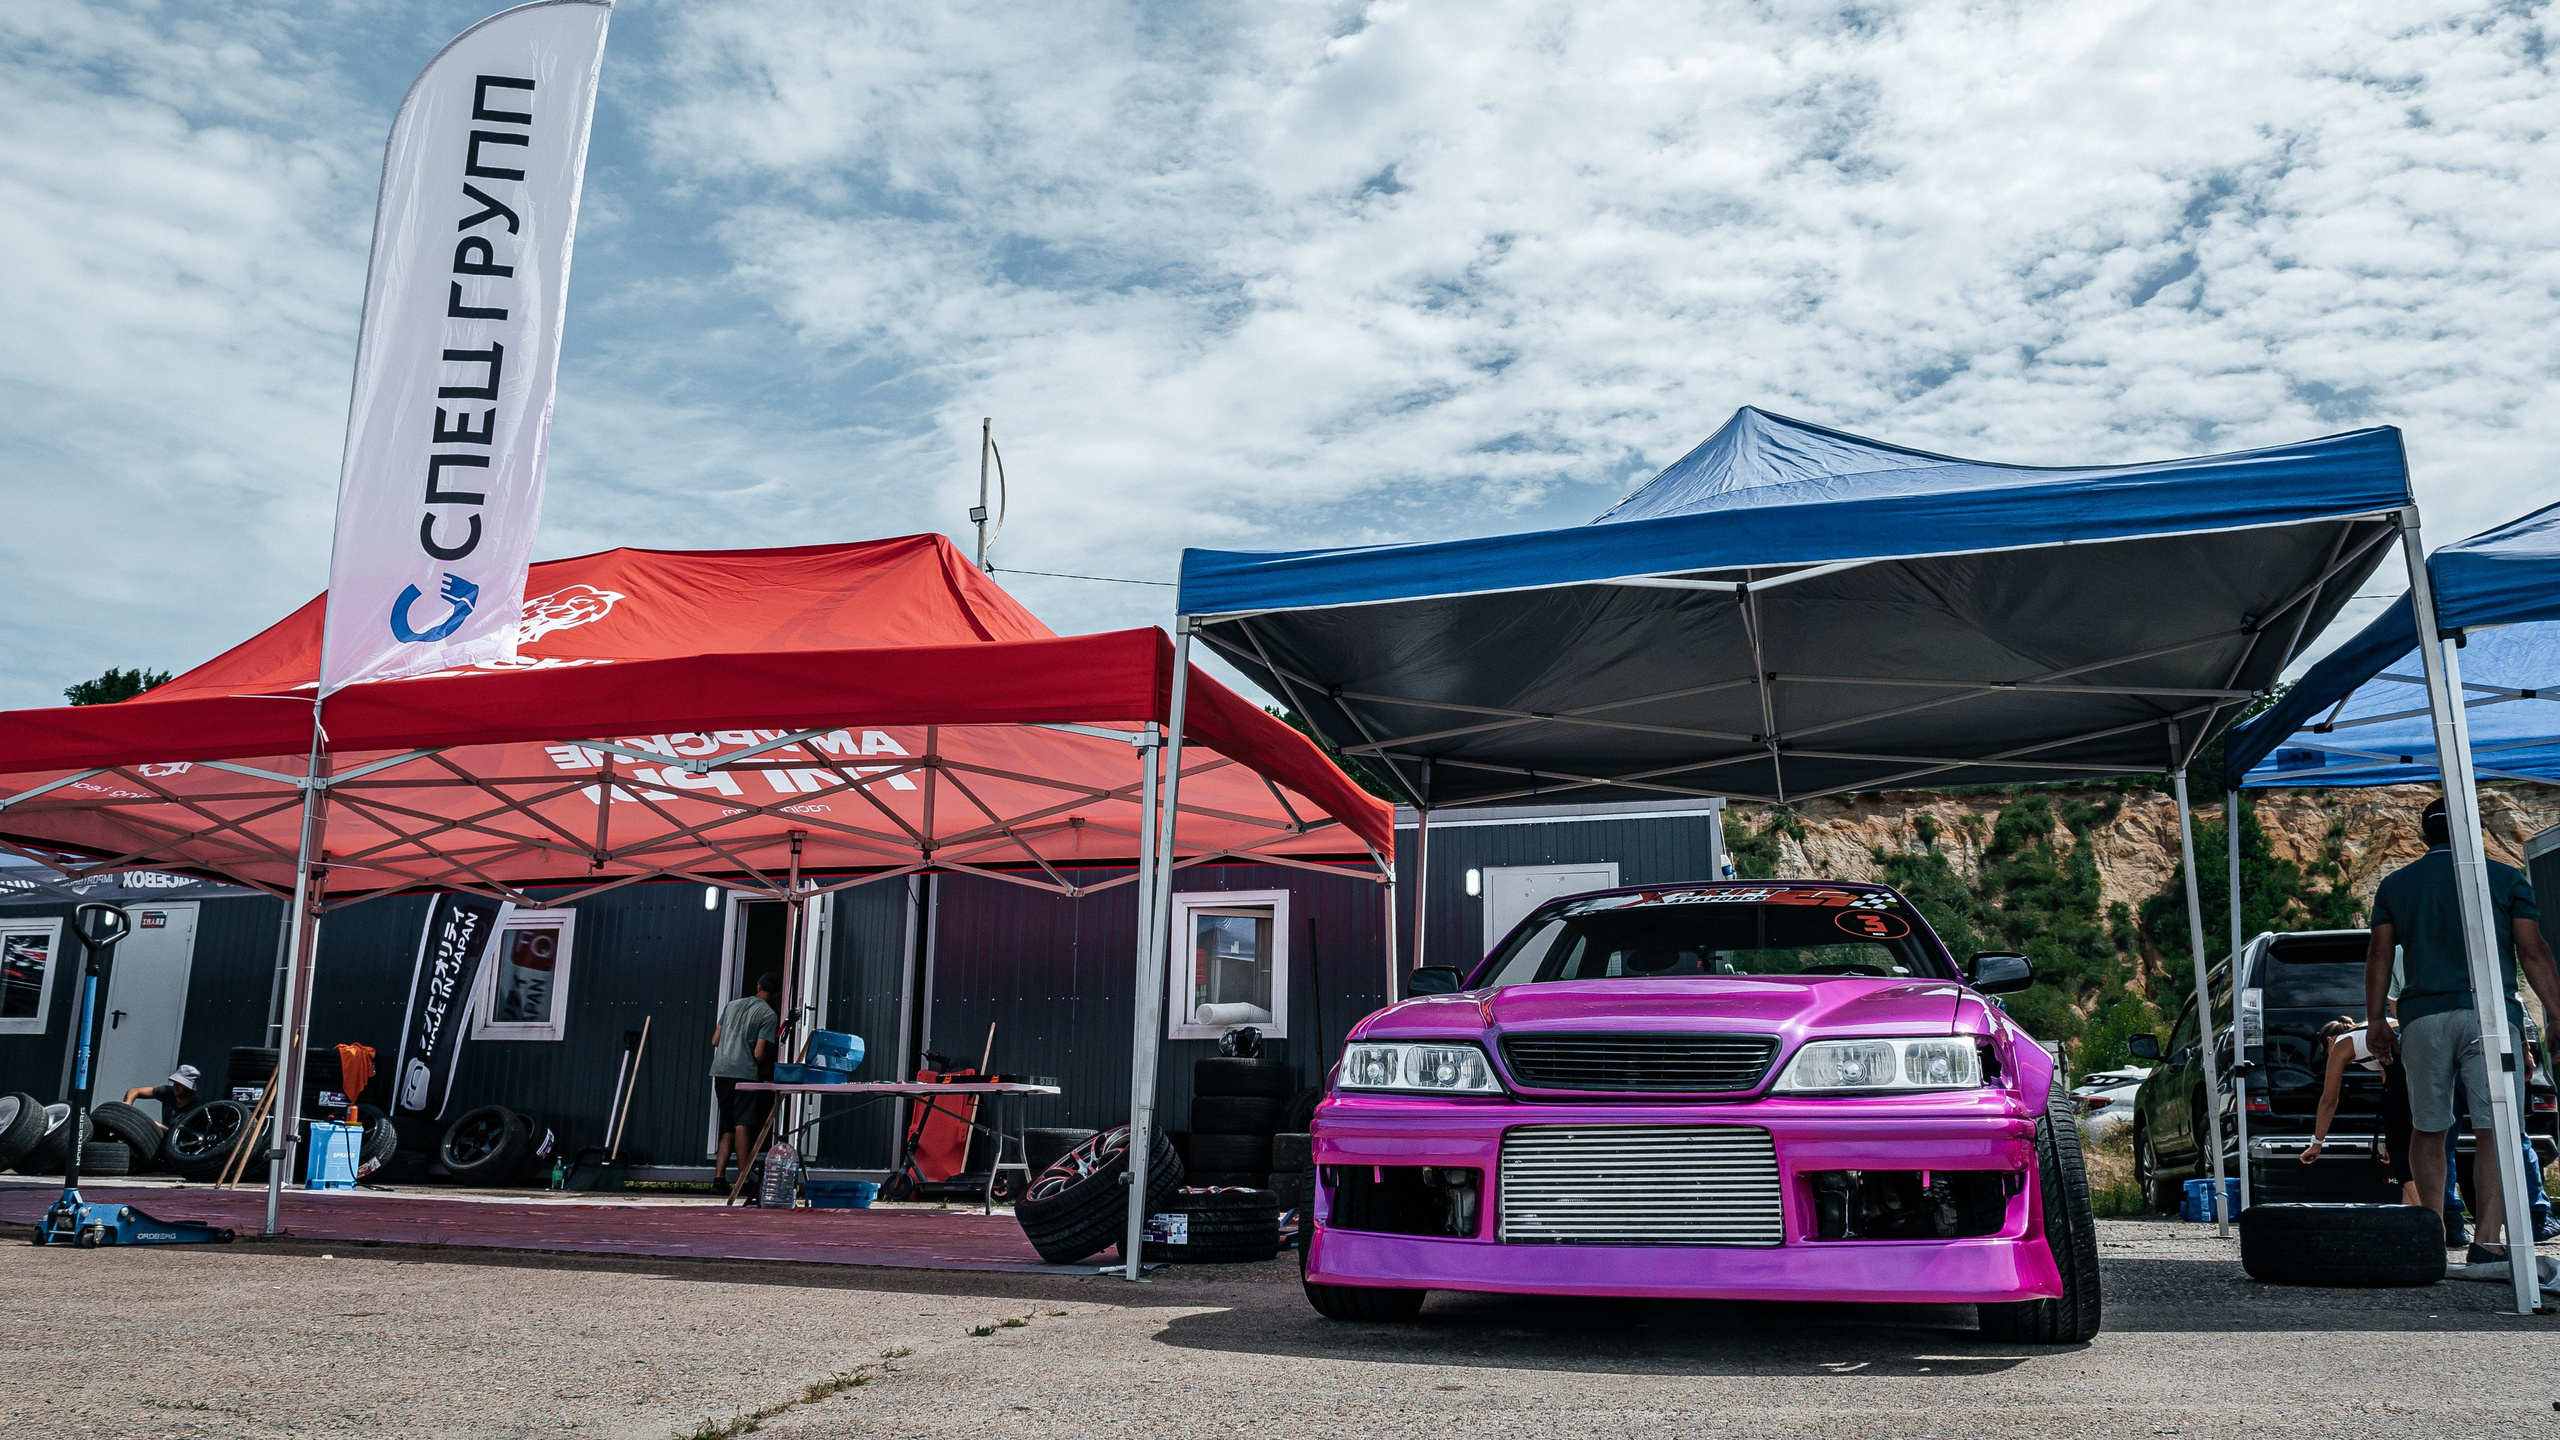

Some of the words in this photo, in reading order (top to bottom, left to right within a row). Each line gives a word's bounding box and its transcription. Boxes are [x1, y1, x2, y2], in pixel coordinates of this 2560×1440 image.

[447, 74, 536, 320] ГРУПП
[420, 340, 503, 561] СПЕЦ
[441, 977, 456, 999] IN
[453, 912, 479, 974] JAPAN
[1857, 915, 1889, 932] 3
[76, 1107, 86, 1166] NORDBERG
